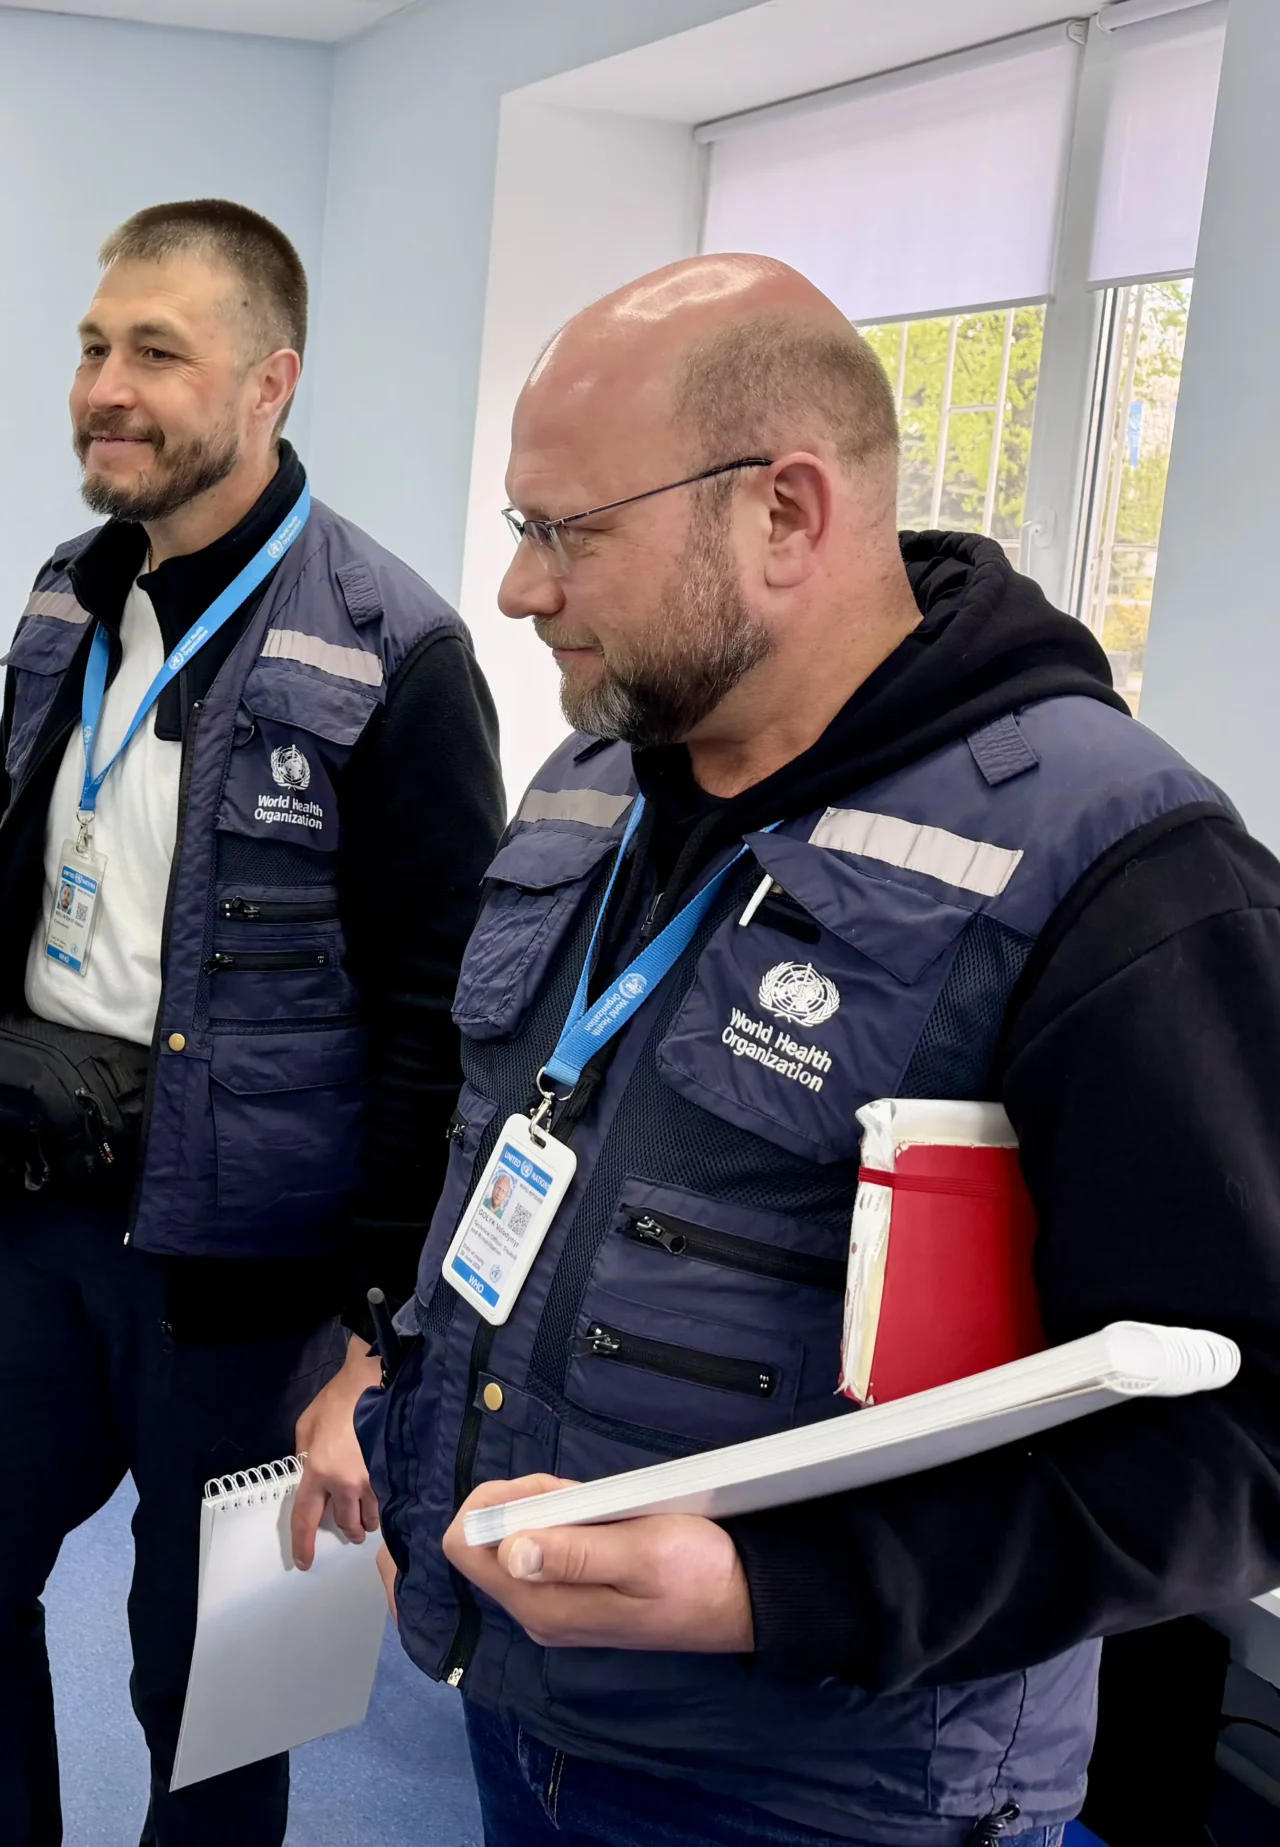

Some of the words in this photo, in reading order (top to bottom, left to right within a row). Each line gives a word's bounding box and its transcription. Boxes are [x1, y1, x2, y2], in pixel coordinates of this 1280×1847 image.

[258, 794, 290, 808] World
[292, 797, 323, 817] Health
[254, 808, 323, 830] Organization
[729, 1007, 774, 1044] World
[774, 1031, 833, 1073] Health
[722, 1026, 824, 1093] Organization
[504, 1151, 522, 1168] UNITED
[468, 1274, 484, 1294] WHO
